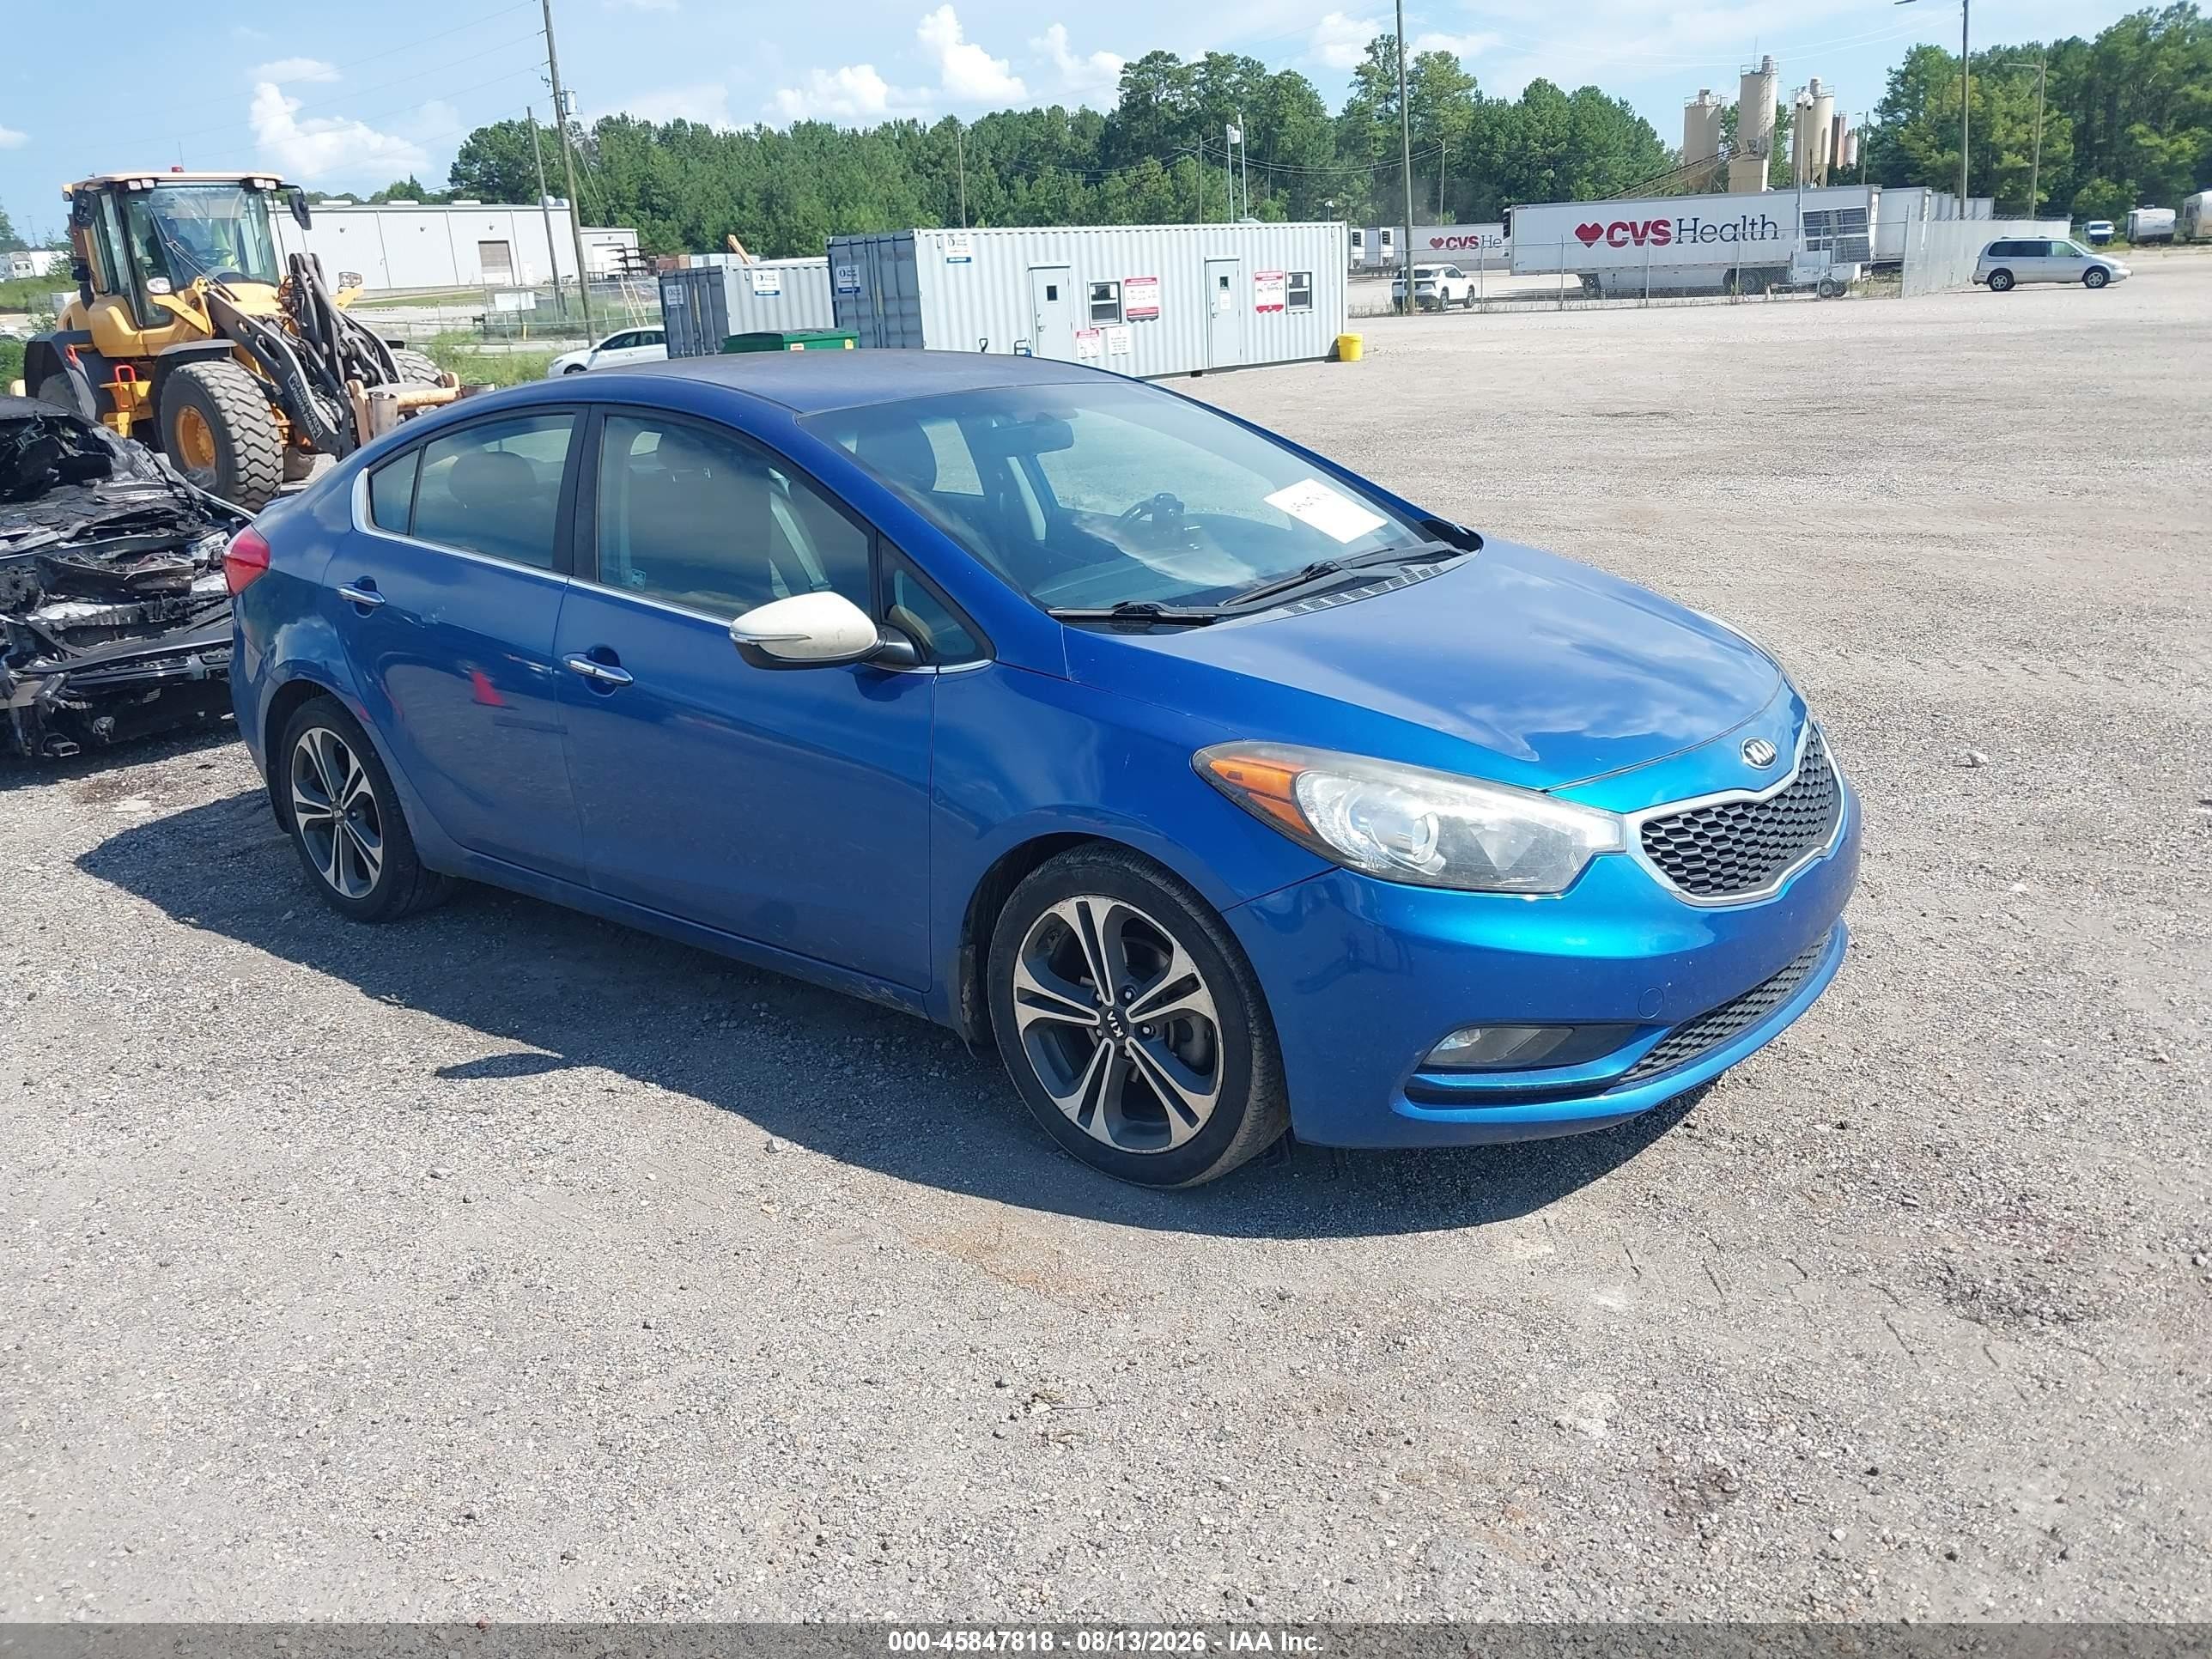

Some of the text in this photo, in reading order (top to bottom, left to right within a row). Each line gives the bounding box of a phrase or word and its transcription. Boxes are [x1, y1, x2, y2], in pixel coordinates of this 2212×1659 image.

[1446, 235, 1480, 251] CVS
[1606, 214, 1780, 248] CVS Health
